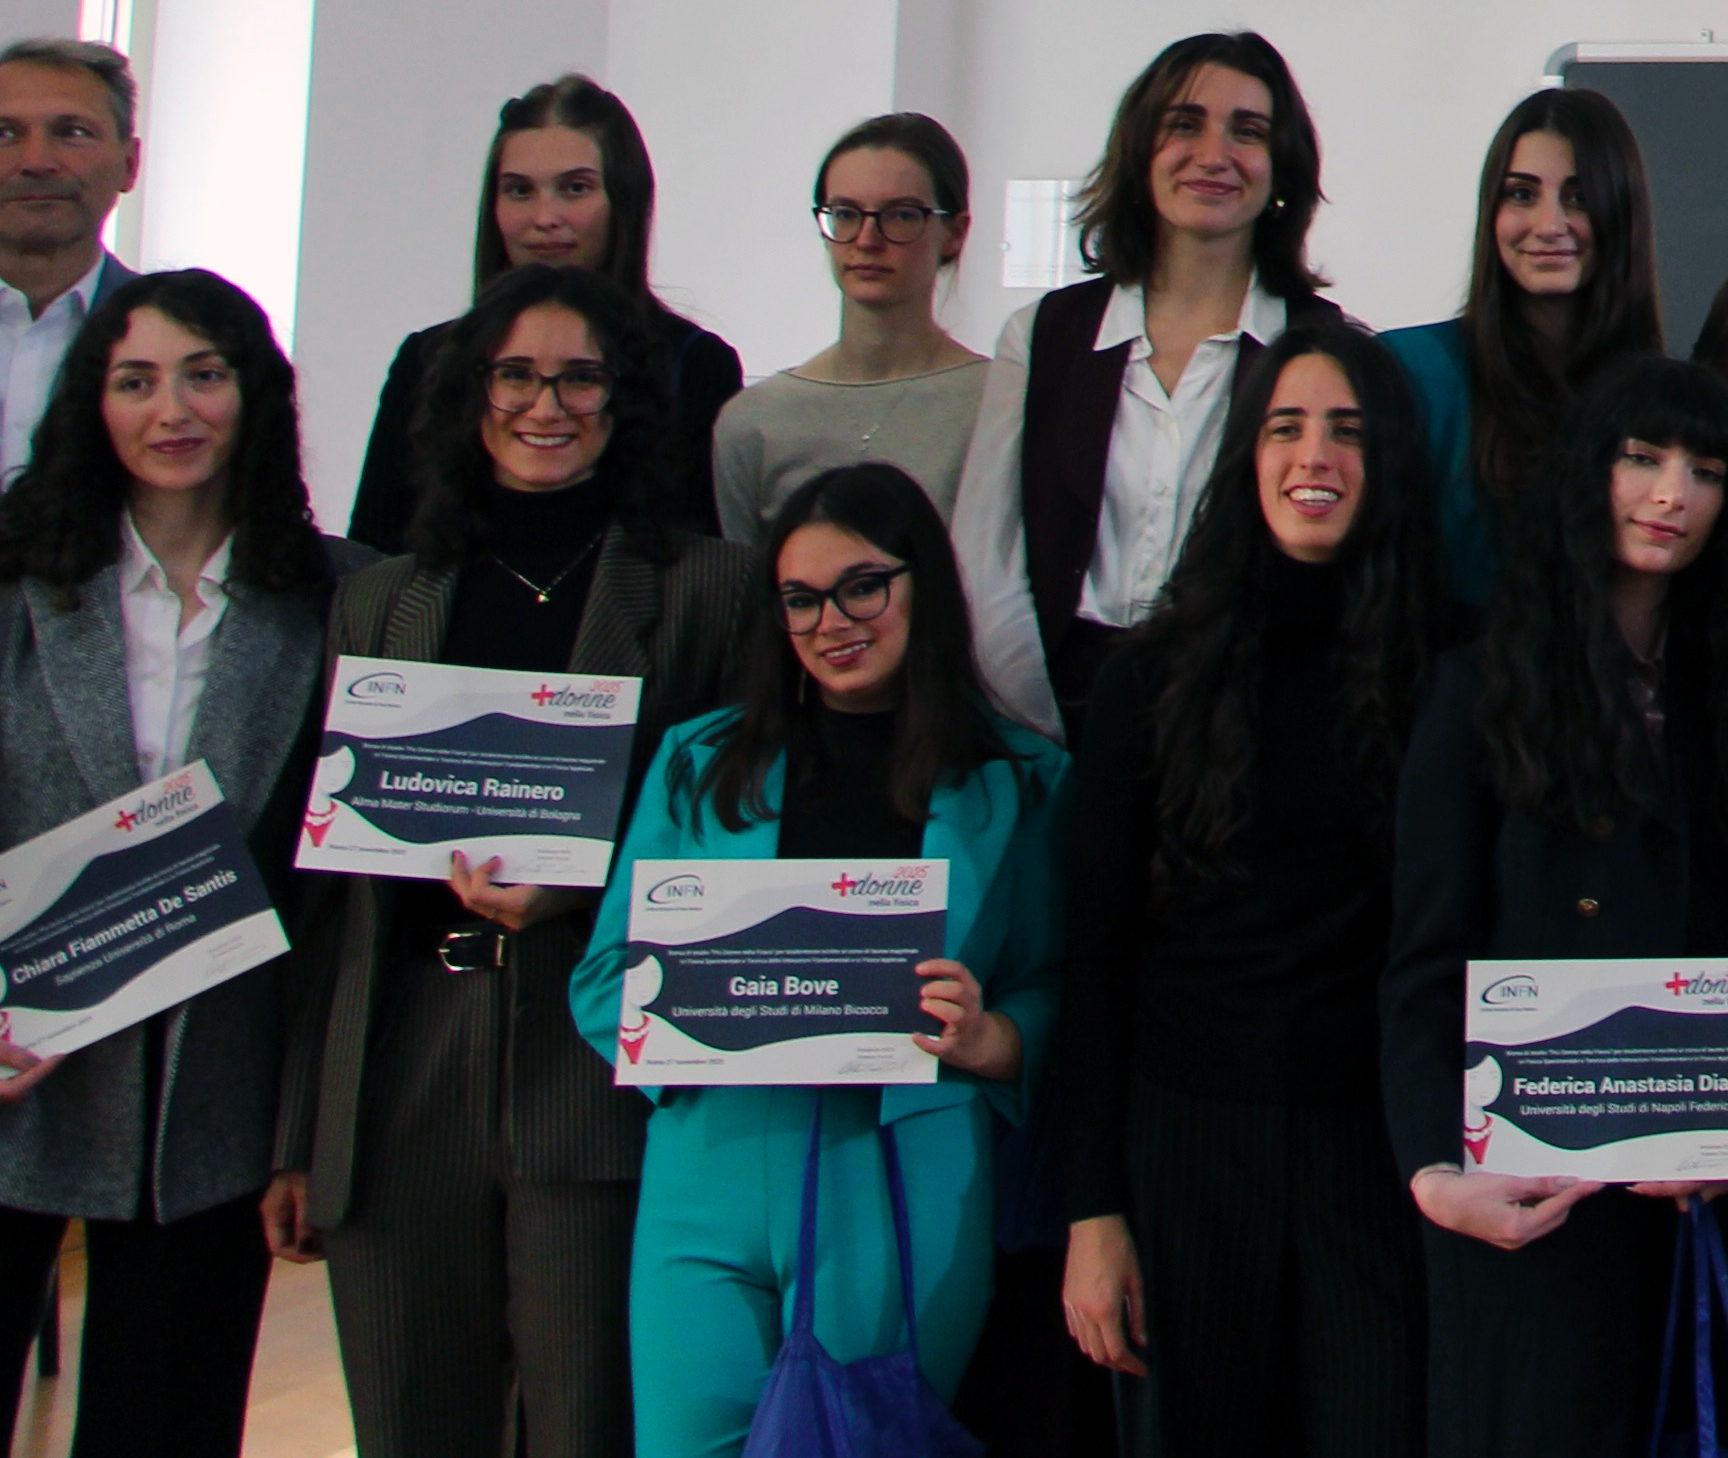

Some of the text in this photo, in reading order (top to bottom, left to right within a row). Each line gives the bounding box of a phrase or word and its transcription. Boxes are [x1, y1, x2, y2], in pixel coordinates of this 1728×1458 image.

[368, 681, 406, 695] INFN
[379, 770, 564, 801] Ludovica Rainero
[666, 885, 704, 897] INFN
[11, 952, 68, 985] Chiara
[68, 907, 158, 959] Fiammetta
[158, 896, 183, 916] De
[184, 869, 238, 903] Santis
[729, 976, 839, 996] Gaia Bove
[1501, 985, 1538, 998] INFN
[672, 1005, 889, 1019] Università degli Studi di Milano Bicocca
[1514, 1076, 1596, 1095] Federica
[1600, 1074, 1694, 1093] Anastasia
[1520, 1104, 1575, 1116] Università
[1578, 1103, 1605, 1117] degli
[1607, 1102, 1636, 1113] Studi
[1639, 1102, 1649, 1113] di
[1651, 1102, 1687, 1115] Napoli
